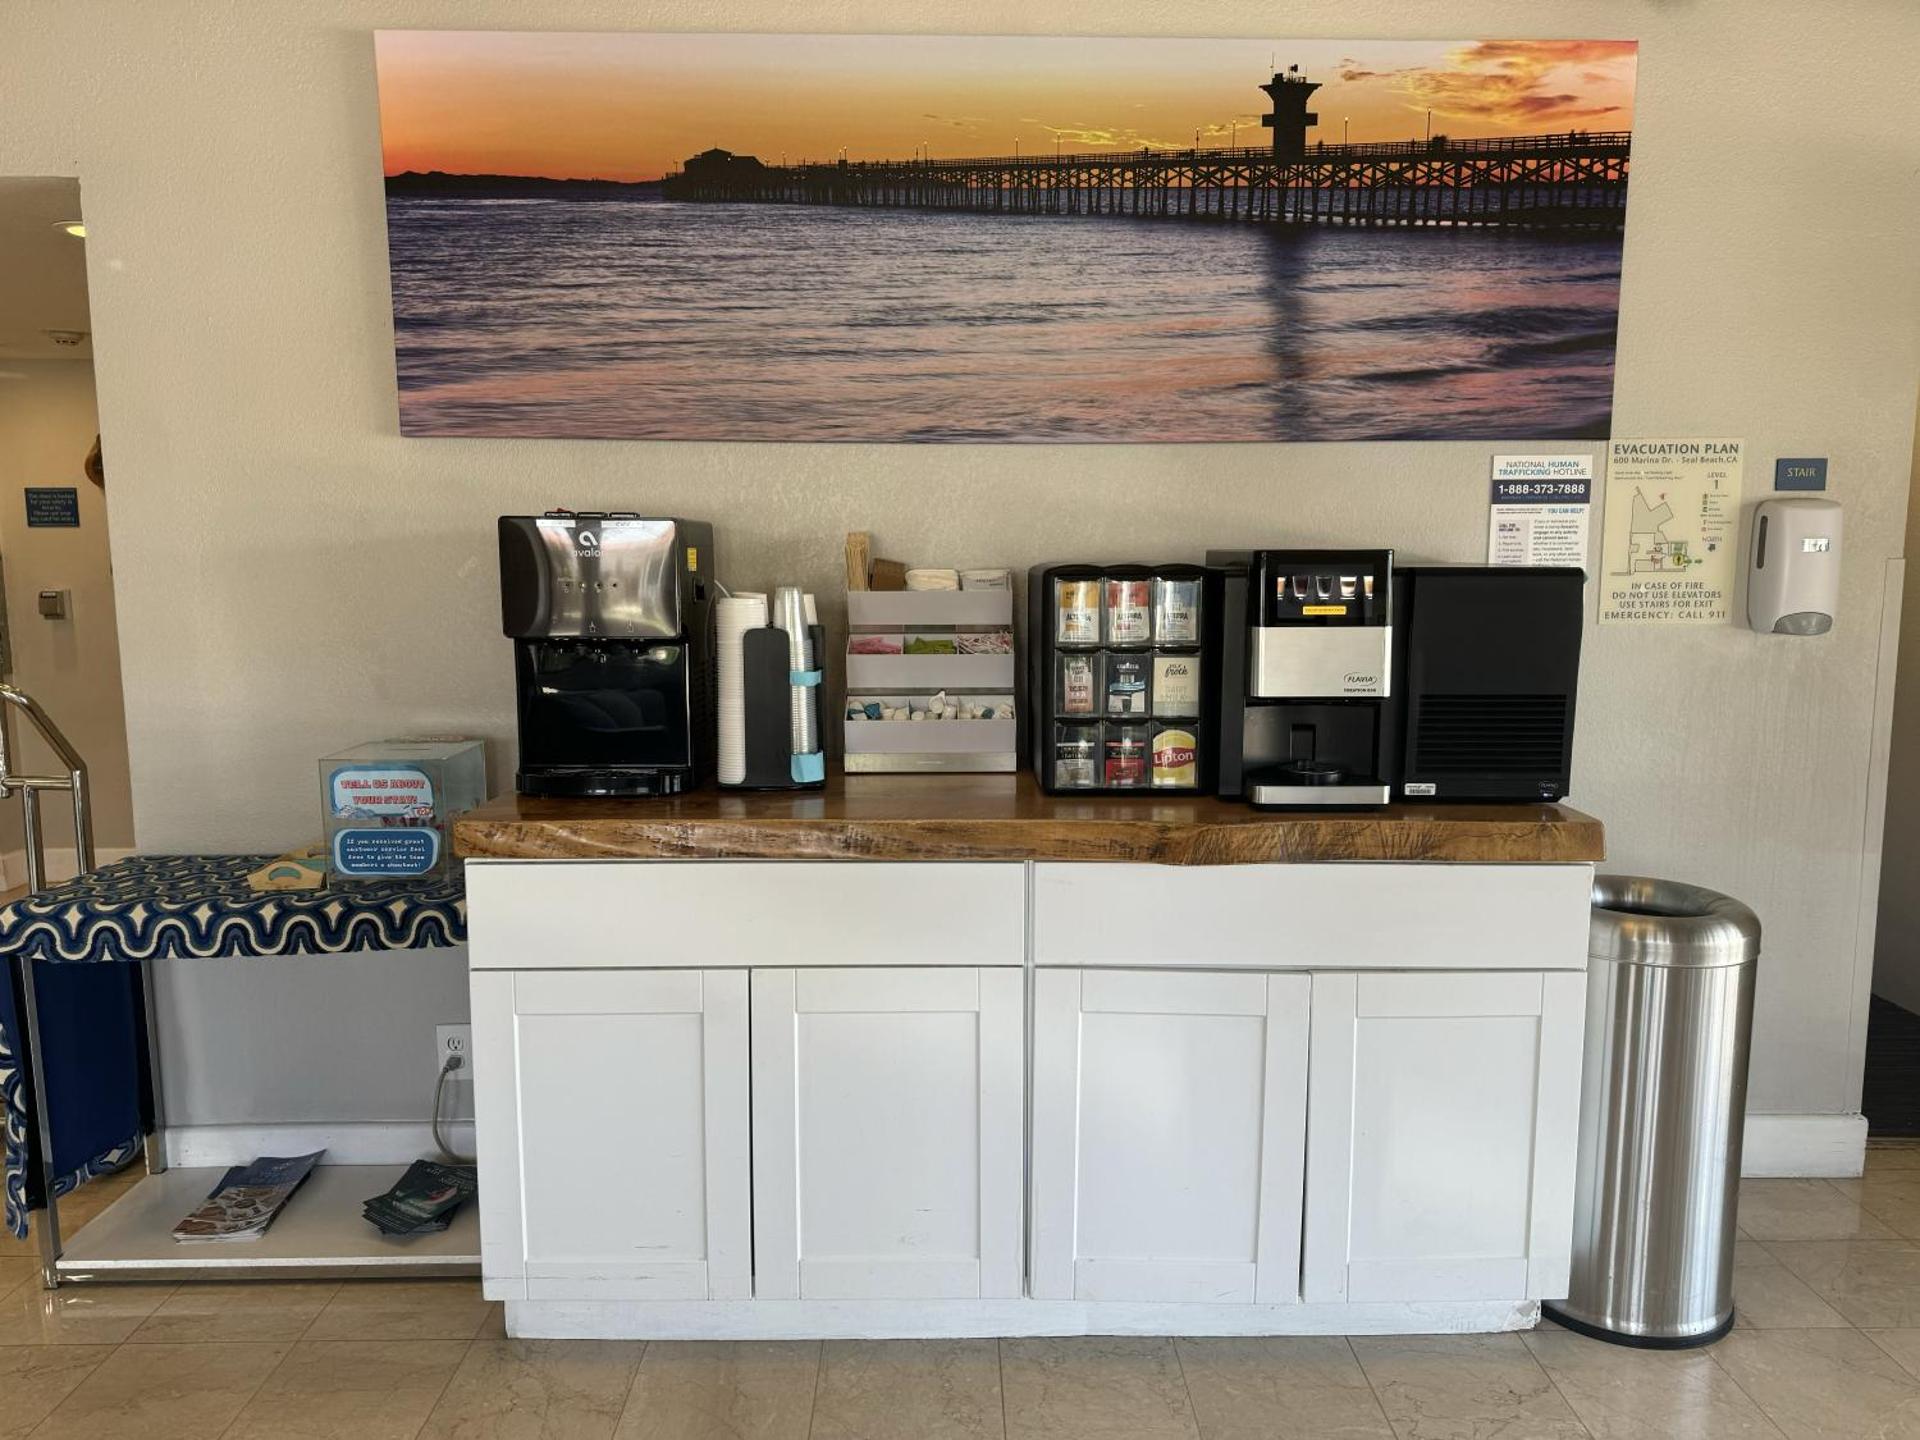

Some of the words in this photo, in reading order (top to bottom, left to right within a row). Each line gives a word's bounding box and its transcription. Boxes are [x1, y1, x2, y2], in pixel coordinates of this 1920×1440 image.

[1614, 444, 1699, 454] EVACUATION
[1705, 444, 1739, 454] PLAN
[1632, 456, 1659, 464] Marina
[1662, 456, 1674, 464] Dr.
[1682, 456, 1698, 464] Seal
[1787, 468, 1817, 477] STAIR
[1499, 484, 1585, 494] 1-888-373-7888
[1631, 582, 1641, 590] IN
[1644, 582, 1667, 590] CASE
[1670, 582, 1682, 590] OF
[1612, 592, 1625, 600] DO
[1672, 591, 1722, 599] ELEVATORS
[1694, 600, 1713, 608] EXIT
[1604, 611, 1673, 620] EMERGENCY:
[1678, 611, 1703, 619] CALL
[1708, 611, 1726, 619] 911
[1165, 665, 1188, 677] froth
[1154, 751, 1194, 765] Lipton
[340, 779, 372, 789] TELL
[372, 779, 388, 789] US
[390, 779, 426, 789] ABOUT
[352, 796, 383, 804] YOUR
